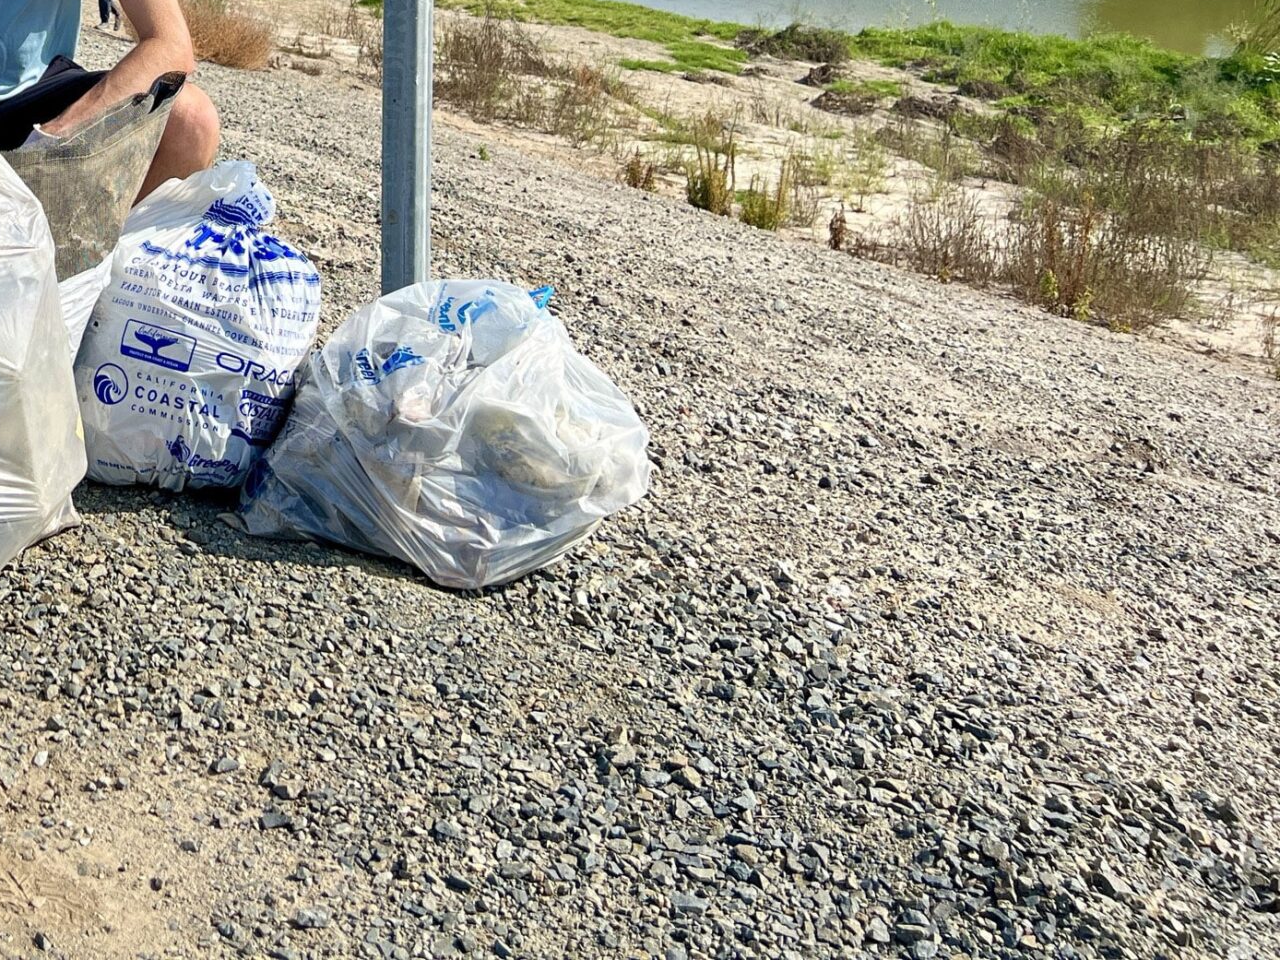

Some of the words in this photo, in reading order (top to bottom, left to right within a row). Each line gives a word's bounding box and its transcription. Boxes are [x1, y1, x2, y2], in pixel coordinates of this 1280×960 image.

[159, 273, 193, 294] DELTA
[172, 263, 207, 285] YOUR
[212, 277, 249, 293] BEACH
[120, 281, 143, 294] YARD
[205, 306, 245, 325] ESTUARY
[224, 330, 250, 344] COVE
[134, 385, 220, 419] COASTAL
[136, 372, 224, 402] CALIFORNIA
[131, 403, 219, 432] COMMISSION
